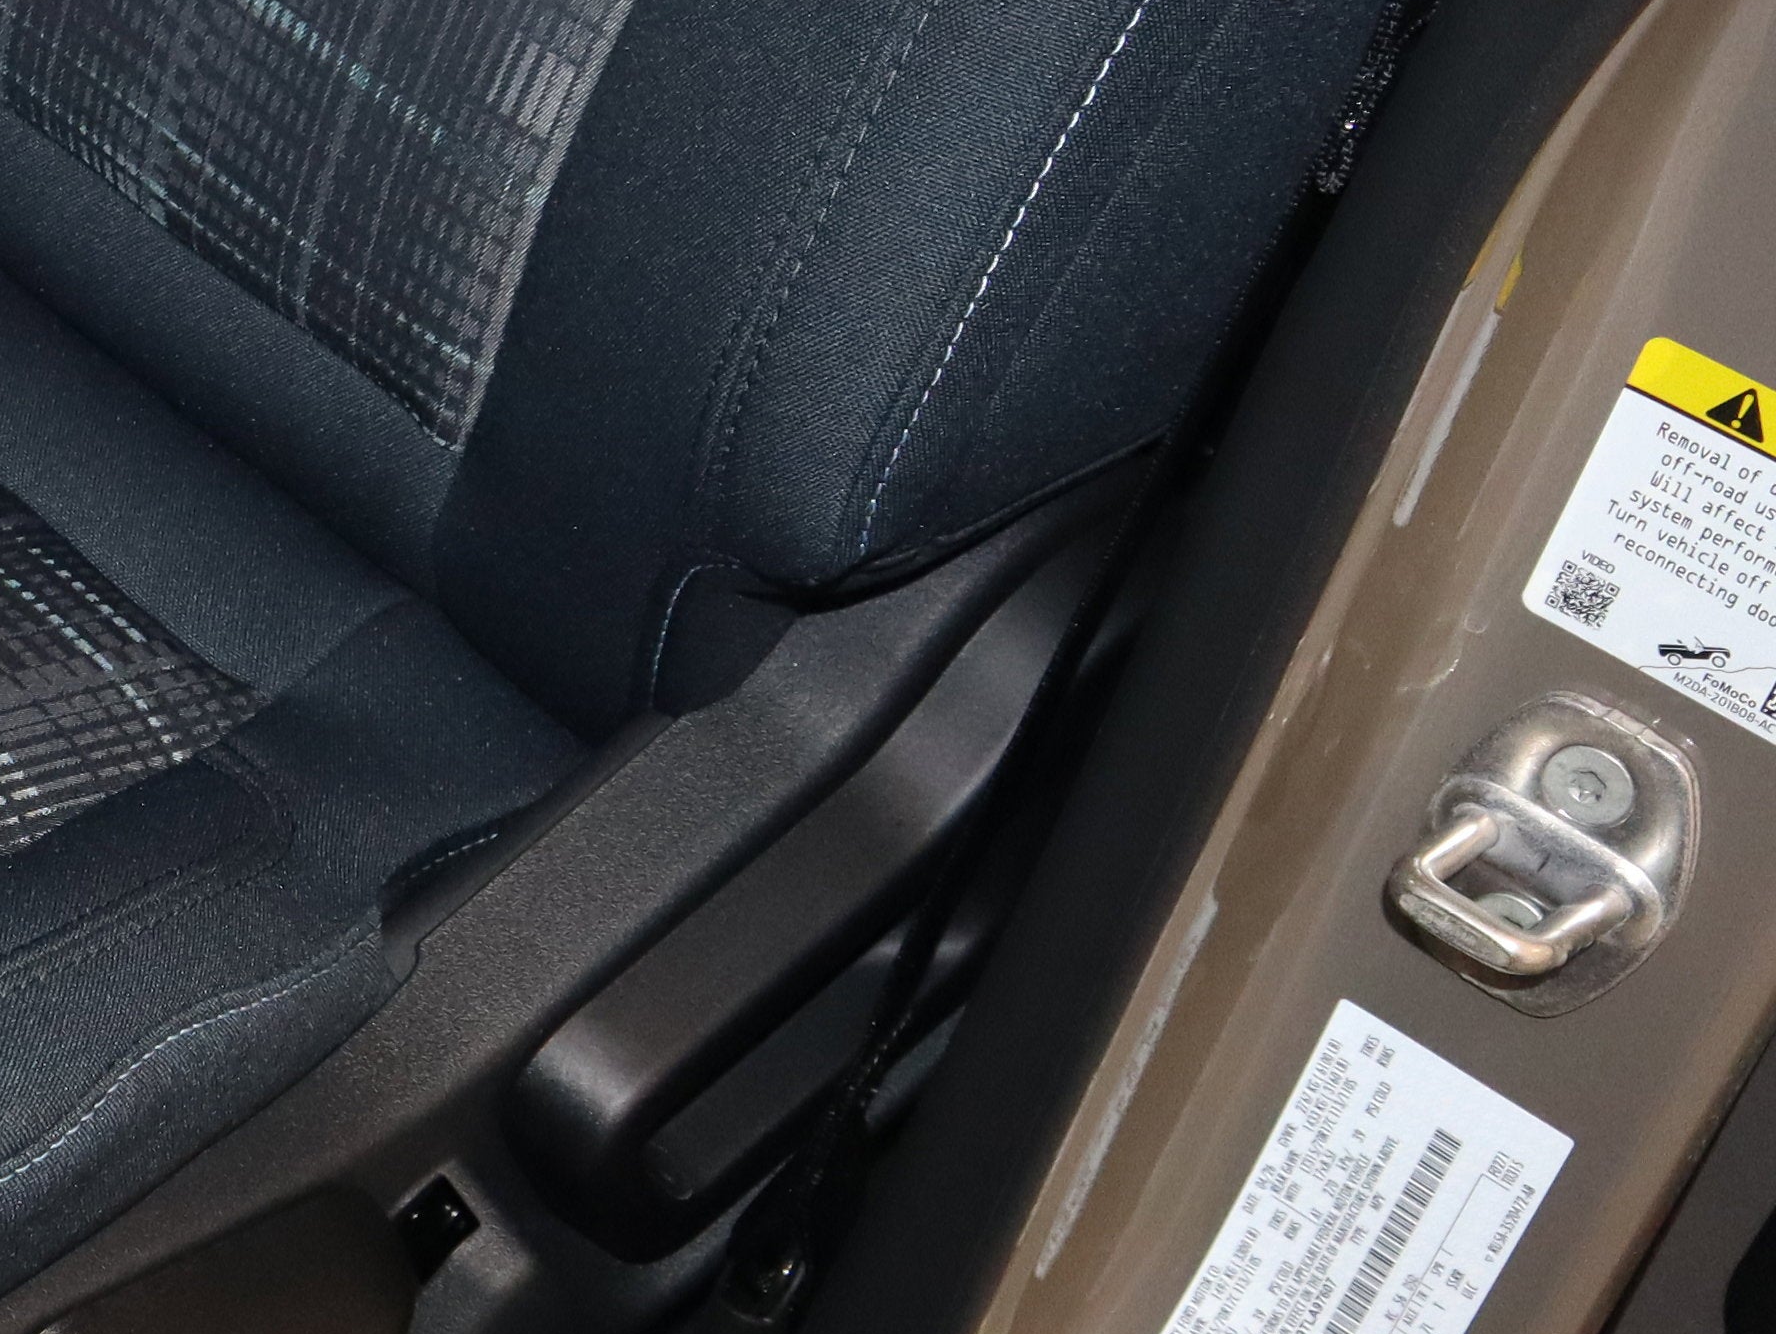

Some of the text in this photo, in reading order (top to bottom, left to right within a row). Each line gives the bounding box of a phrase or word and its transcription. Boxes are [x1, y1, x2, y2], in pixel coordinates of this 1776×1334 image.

[1656, 421, 1763, 484] Removal of
[1661, 454, 1749, 505] off-road
[1629, 490, 1776, 575] system perform
[1650, 470, 1766, 541] Will affect
[1581, 549, 1617, 575] VIDEO
[1607, 499, 1771, 594] Turn vehicle off
[1614, 533, 1740, 609] reconnecting
[1702, 673, 1757, 709] FoMoCo
[1359, 1033, 1380, 1058] TIRES
[1313, 1210, 1339, 1244] FEDERAL
[1330, 1182, 1354, 1212] MOTOR
[1345, 1152, 1371, 1185] VEHICLE
[1330, 1190, 1368, 1245] MANUFACTURE
